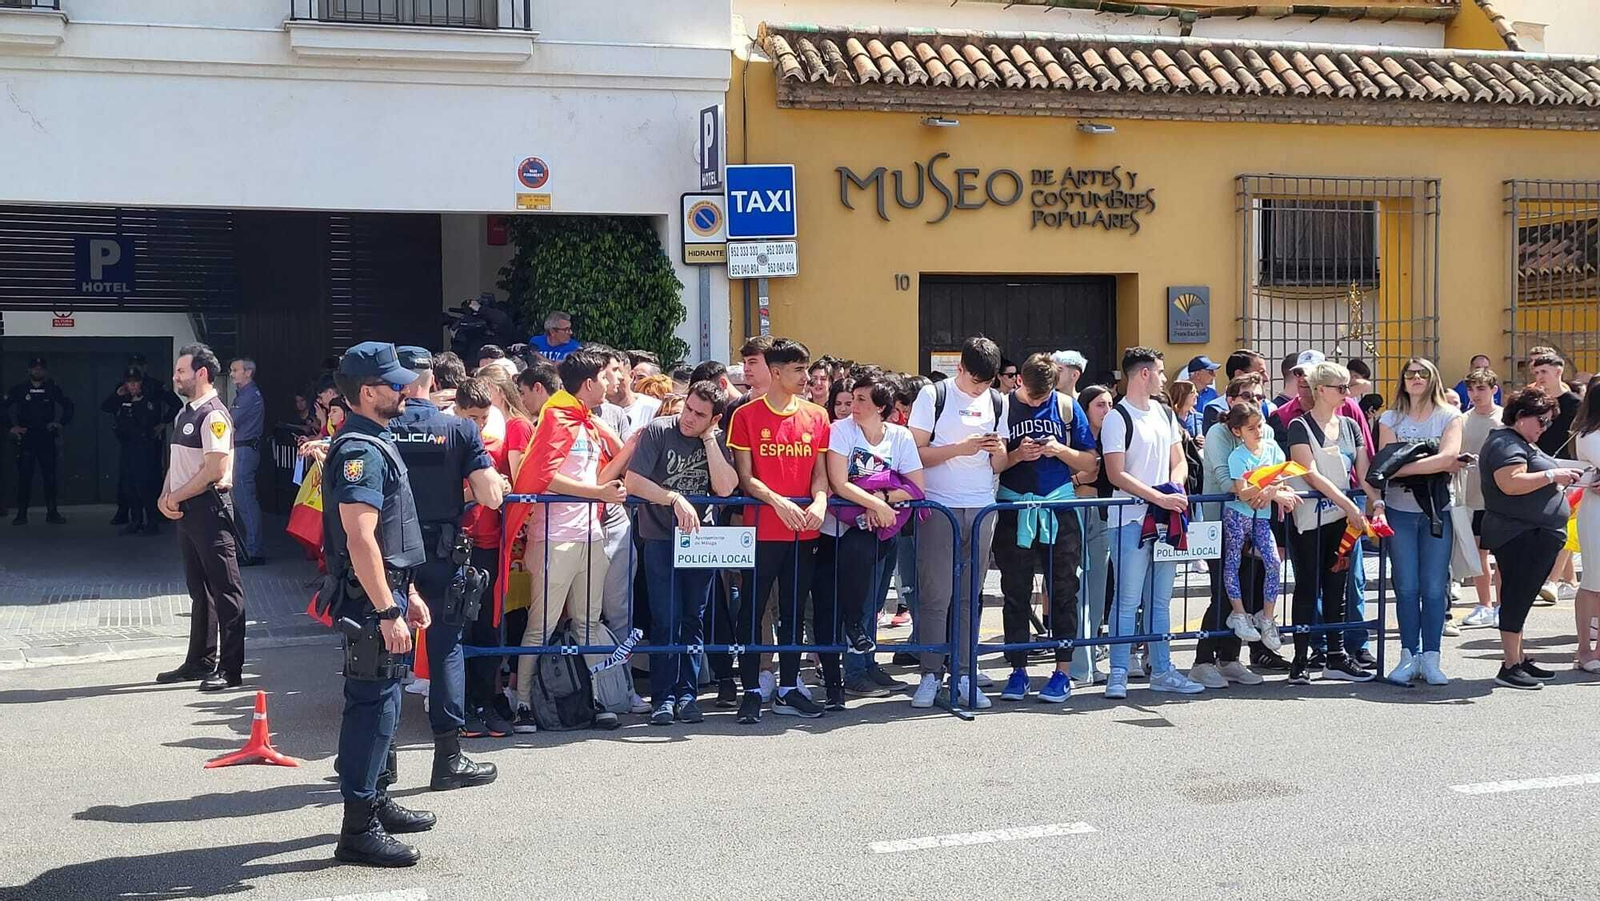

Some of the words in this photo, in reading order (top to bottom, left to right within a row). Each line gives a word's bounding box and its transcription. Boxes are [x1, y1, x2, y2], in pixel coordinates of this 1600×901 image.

[704, 112, 714, 169] P
[702, 171, 718, 187] HOTEL
[1031, 169, 1057, 186] DE
[1060, 166, 1122, 190] ARTES
[1126, 171, 1138, 190] Y
[834, 152, 1024, 224] MUSEO
[730, 190, 791, 213] TAXI
[1030, 187, 1156, 214] COSTUMBRES
[1030, 210, 1140, 236] POPULARES
[90, 240, 121, 280] P
[730, 246, 739, 257] 952
[82, 282, 131, 292] HOTEL
[894, 274, 910, 291] 10
[390, 433, 437, 442] OLICIA
[1009, 420, 1062, 440] HUDSON
[760, 441, 812, 456] ESPAÑA
[678, 552, 718, 563] POLICÍA
[722, 554, 753, 563] LOCAL
[1192, 547, 1218, 556] LOCAL
